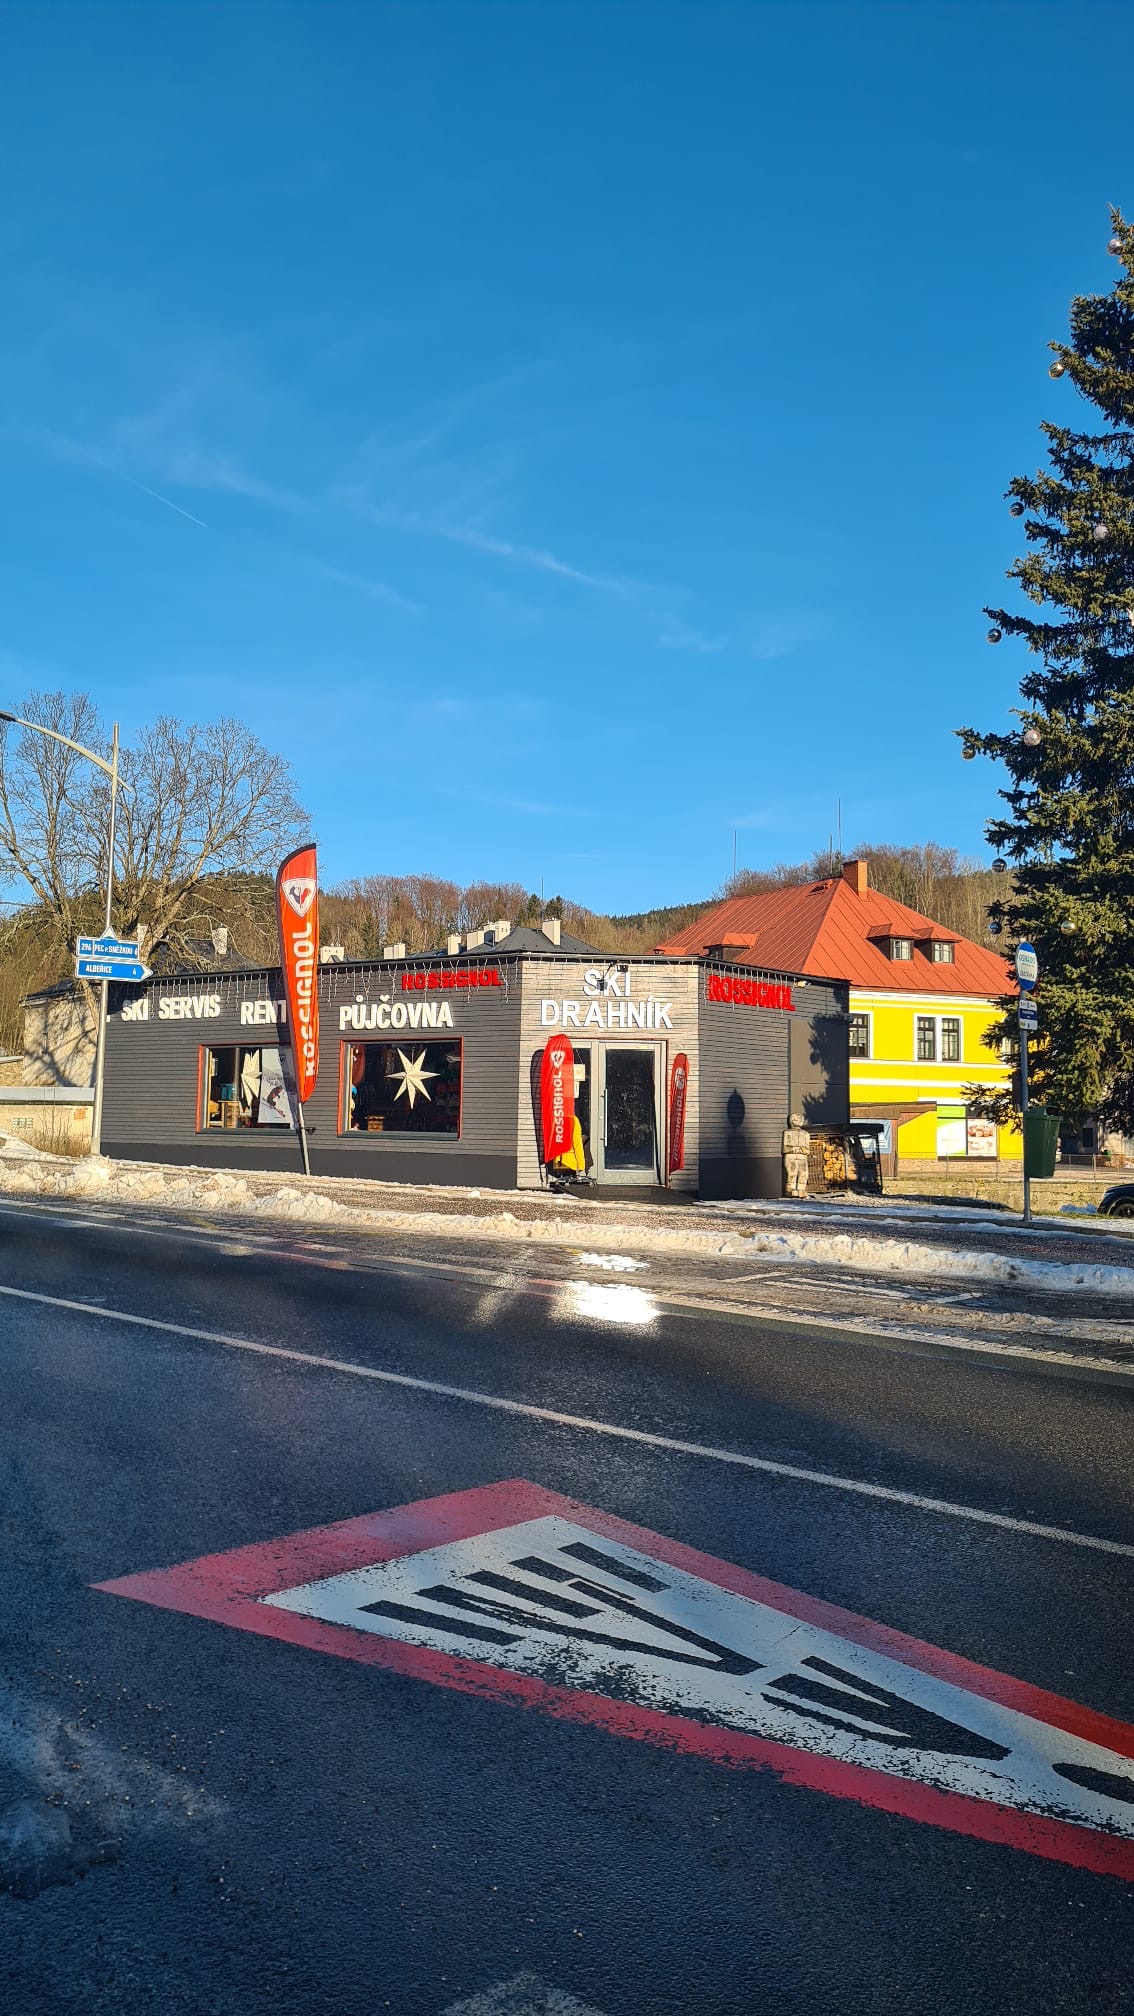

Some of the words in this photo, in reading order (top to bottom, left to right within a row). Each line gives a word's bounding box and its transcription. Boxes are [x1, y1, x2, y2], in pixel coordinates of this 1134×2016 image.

[94, 944, 104, 952] PEC
[85, 964, 113, 974] ALBEŘICE
[402, 968, 504, 991] ROSSIGNOL
[583, 968, 631, 997] SKI
[121, 998, 149, 1021] SKI
[159, 995, 221, 1020] SERVIS
[292, 922, 315, 1077] ROSSIGNOL
[707, 974, 797, 1011] ROSSIGNOL
[339, 995, 454, 1031] PŮJČOVNA
[540, 995, 674, 1029] DRAHNÍK
[553, 1071, 564, 1143] ROSSIGNOL
